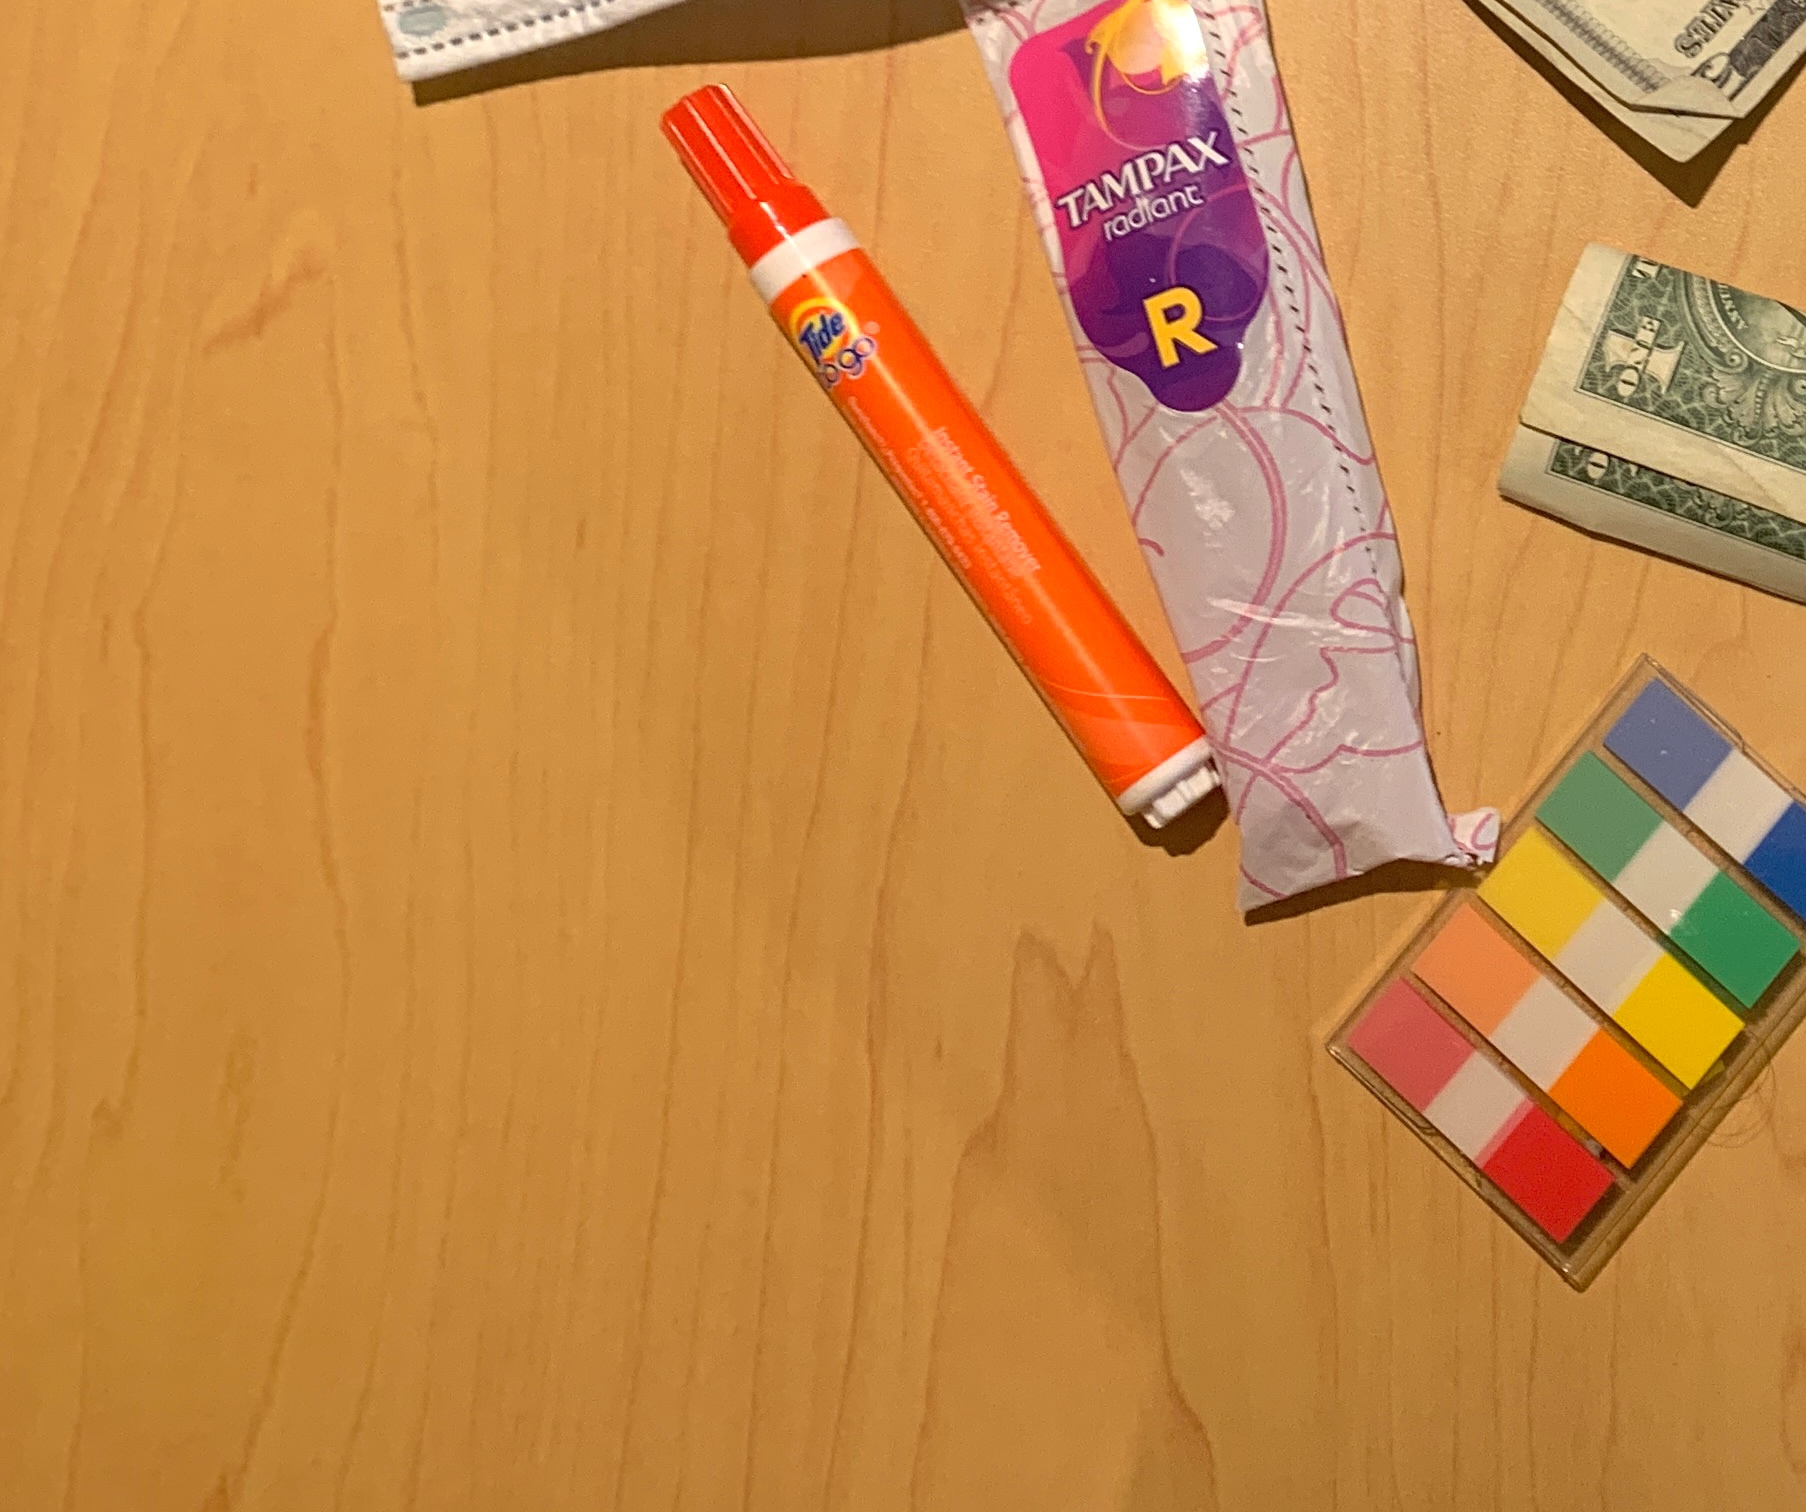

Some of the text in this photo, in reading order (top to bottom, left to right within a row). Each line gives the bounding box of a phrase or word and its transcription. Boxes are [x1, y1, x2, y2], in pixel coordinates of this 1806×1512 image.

[1056, 131, 1230, 230] TAMPAX
[1103, 184, 1203, 242] radiant
[799, 313, 845, 367] Tide
[838, 338, 876, 376] go
[1144, 287, 1219, 368] R
[931, 423, 1043, 575] Instant Stain Remover
